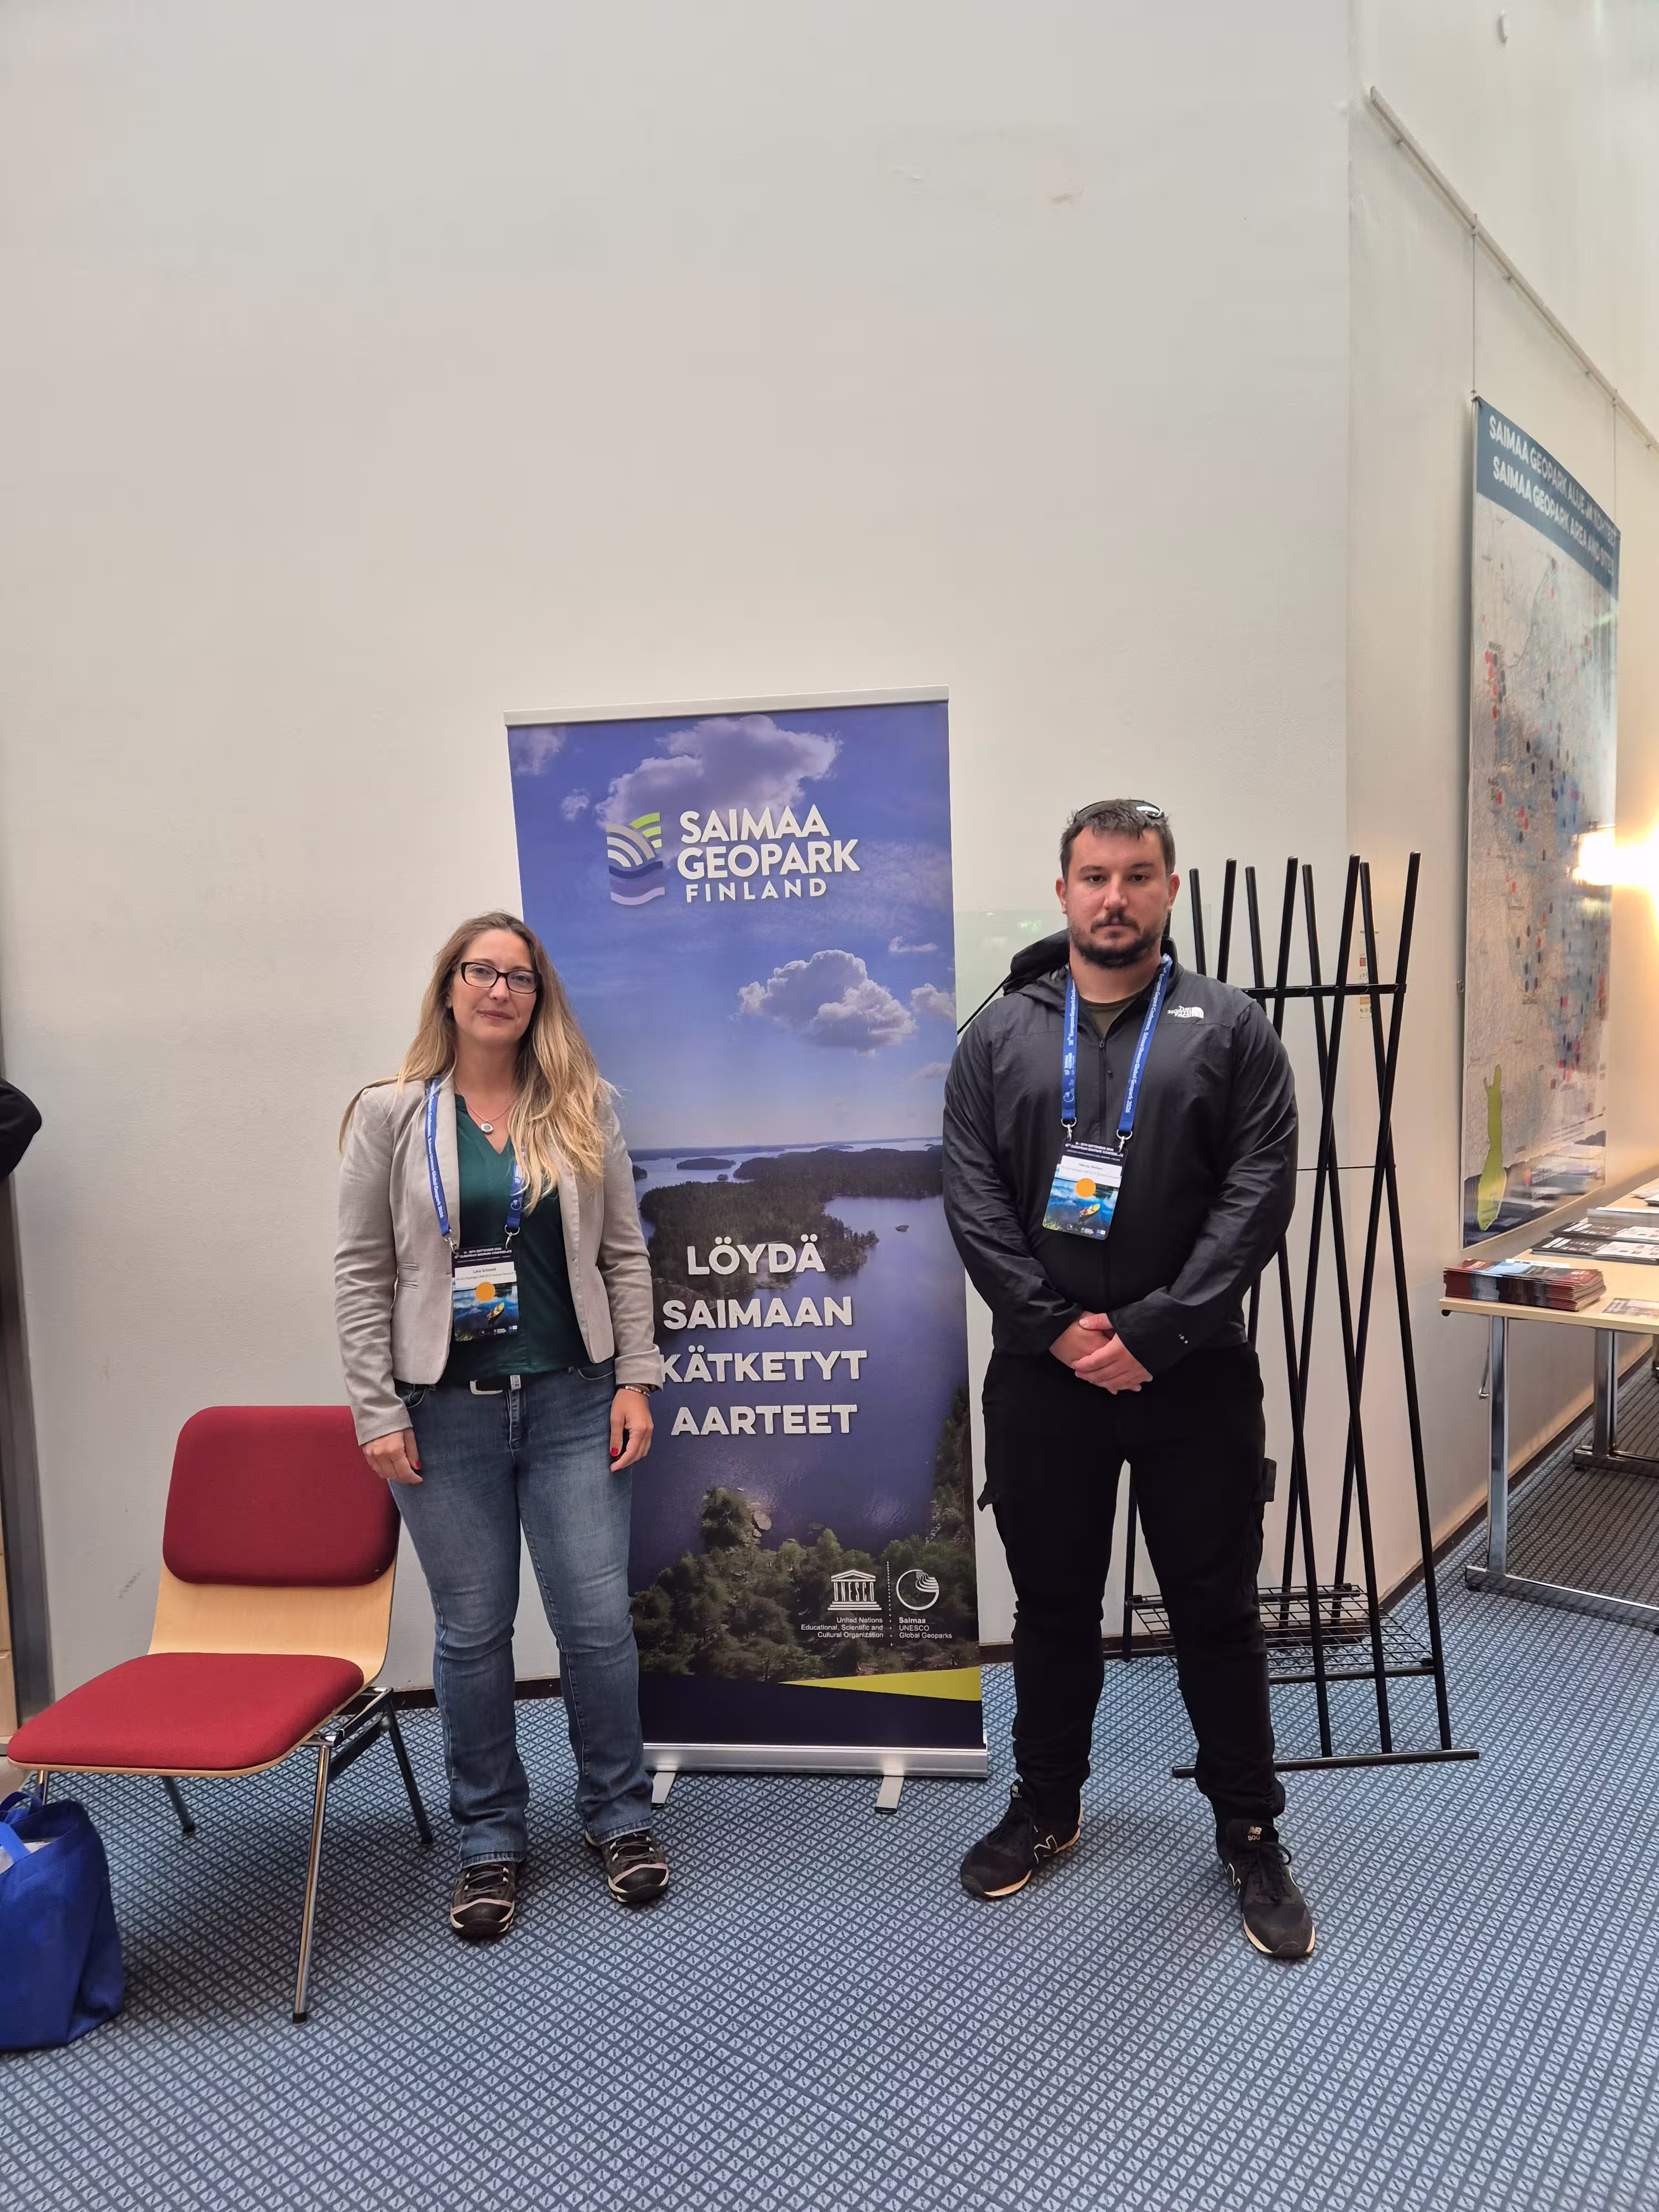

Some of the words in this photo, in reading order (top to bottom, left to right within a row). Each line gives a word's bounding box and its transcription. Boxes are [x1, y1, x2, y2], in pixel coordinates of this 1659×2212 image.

[1489, 414, 1529, 464] SAIMAA
[1530, 447, 1567, 498] GEOPARK
[1493, 456, 1532, 503] SAIMAA
[1533, 485, 1569, 534] GEOPARK
[680, 804, 830, 844] SAIMAA
[677, 838, 860, 880] GEOPARK
[686, 878, 827, 902] FINLAND
[687, 1234, 826, 1275] LÖYDÄ
[662, 1296, 852, 1329] SAIMAAN
[659, 1345, 868, 1383] KÄTKETYT
[671, 1404, 858, 1436] AARTEET
[833, 1582, 875, 1601] UNESCO
